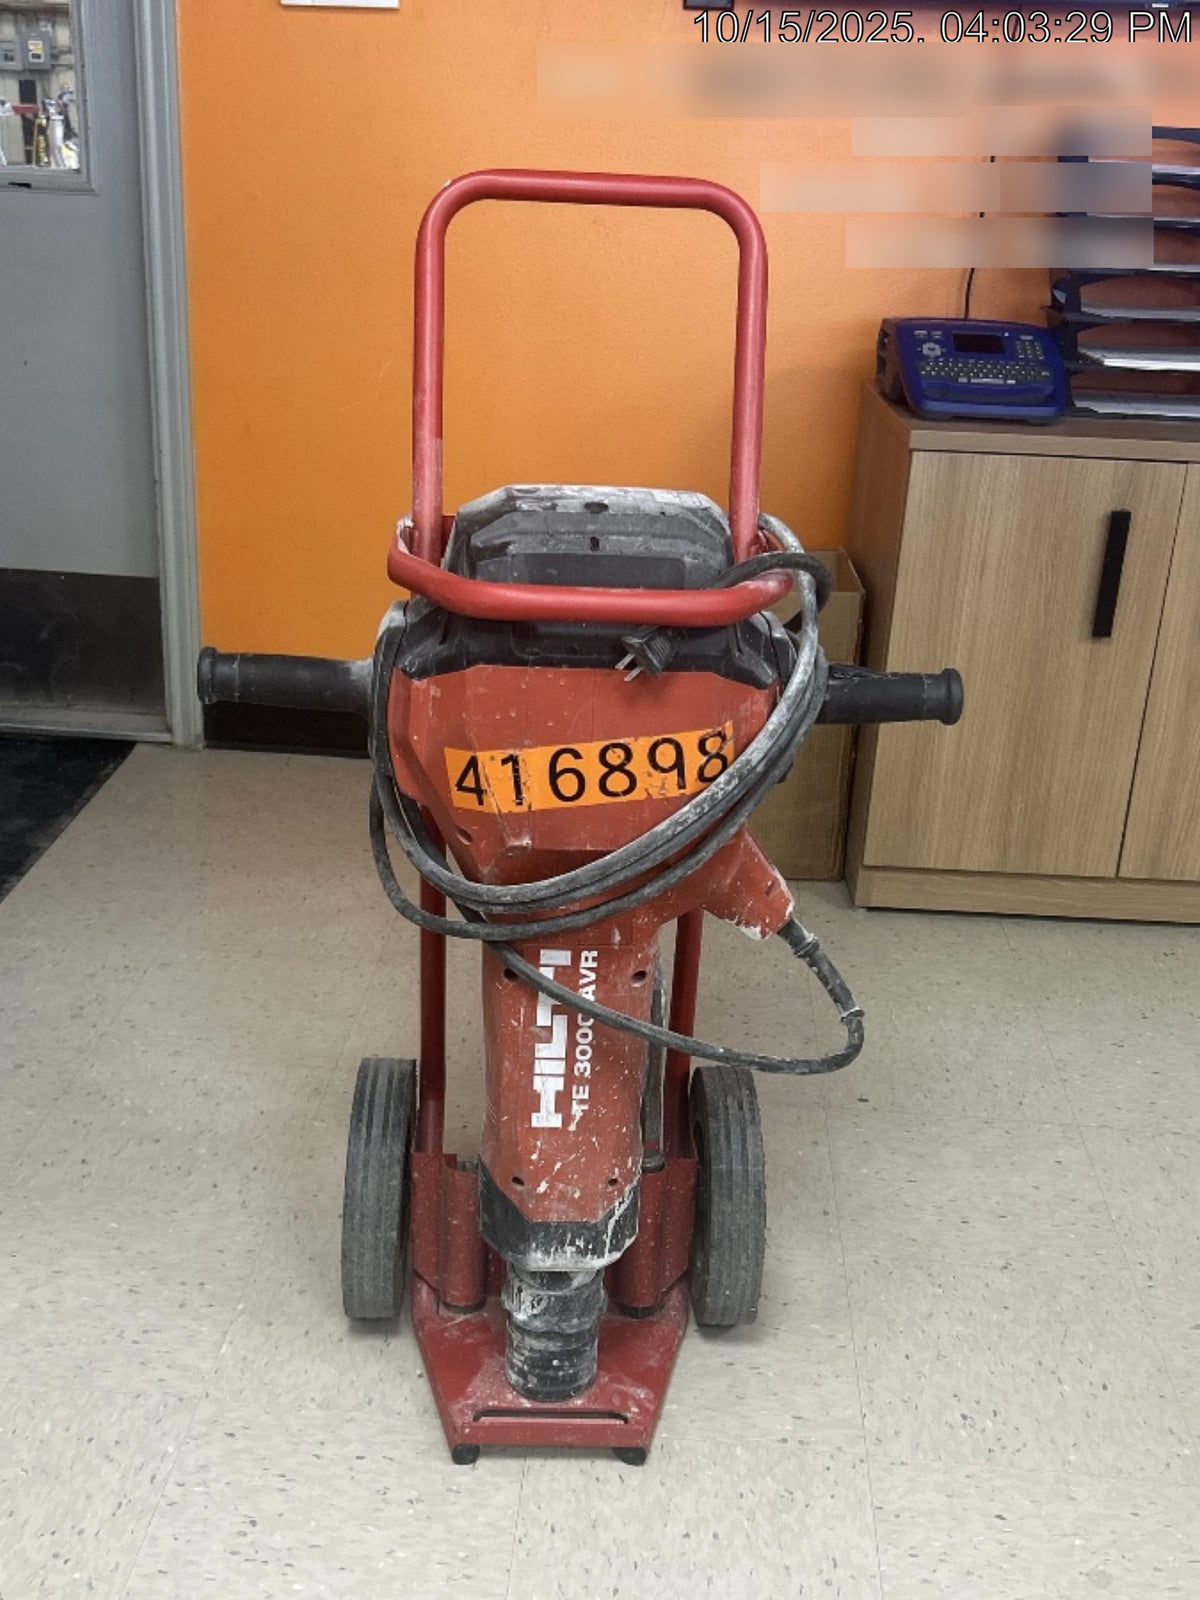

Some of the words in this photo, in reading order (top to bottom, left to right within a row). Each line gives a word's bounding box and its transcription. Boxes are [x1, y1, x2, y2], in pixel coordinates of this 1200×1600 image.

[455, 729, 729, 806] 416898
[578, 950, 598, 1002] AVR
[572, 1084, 589, 1116] TE
